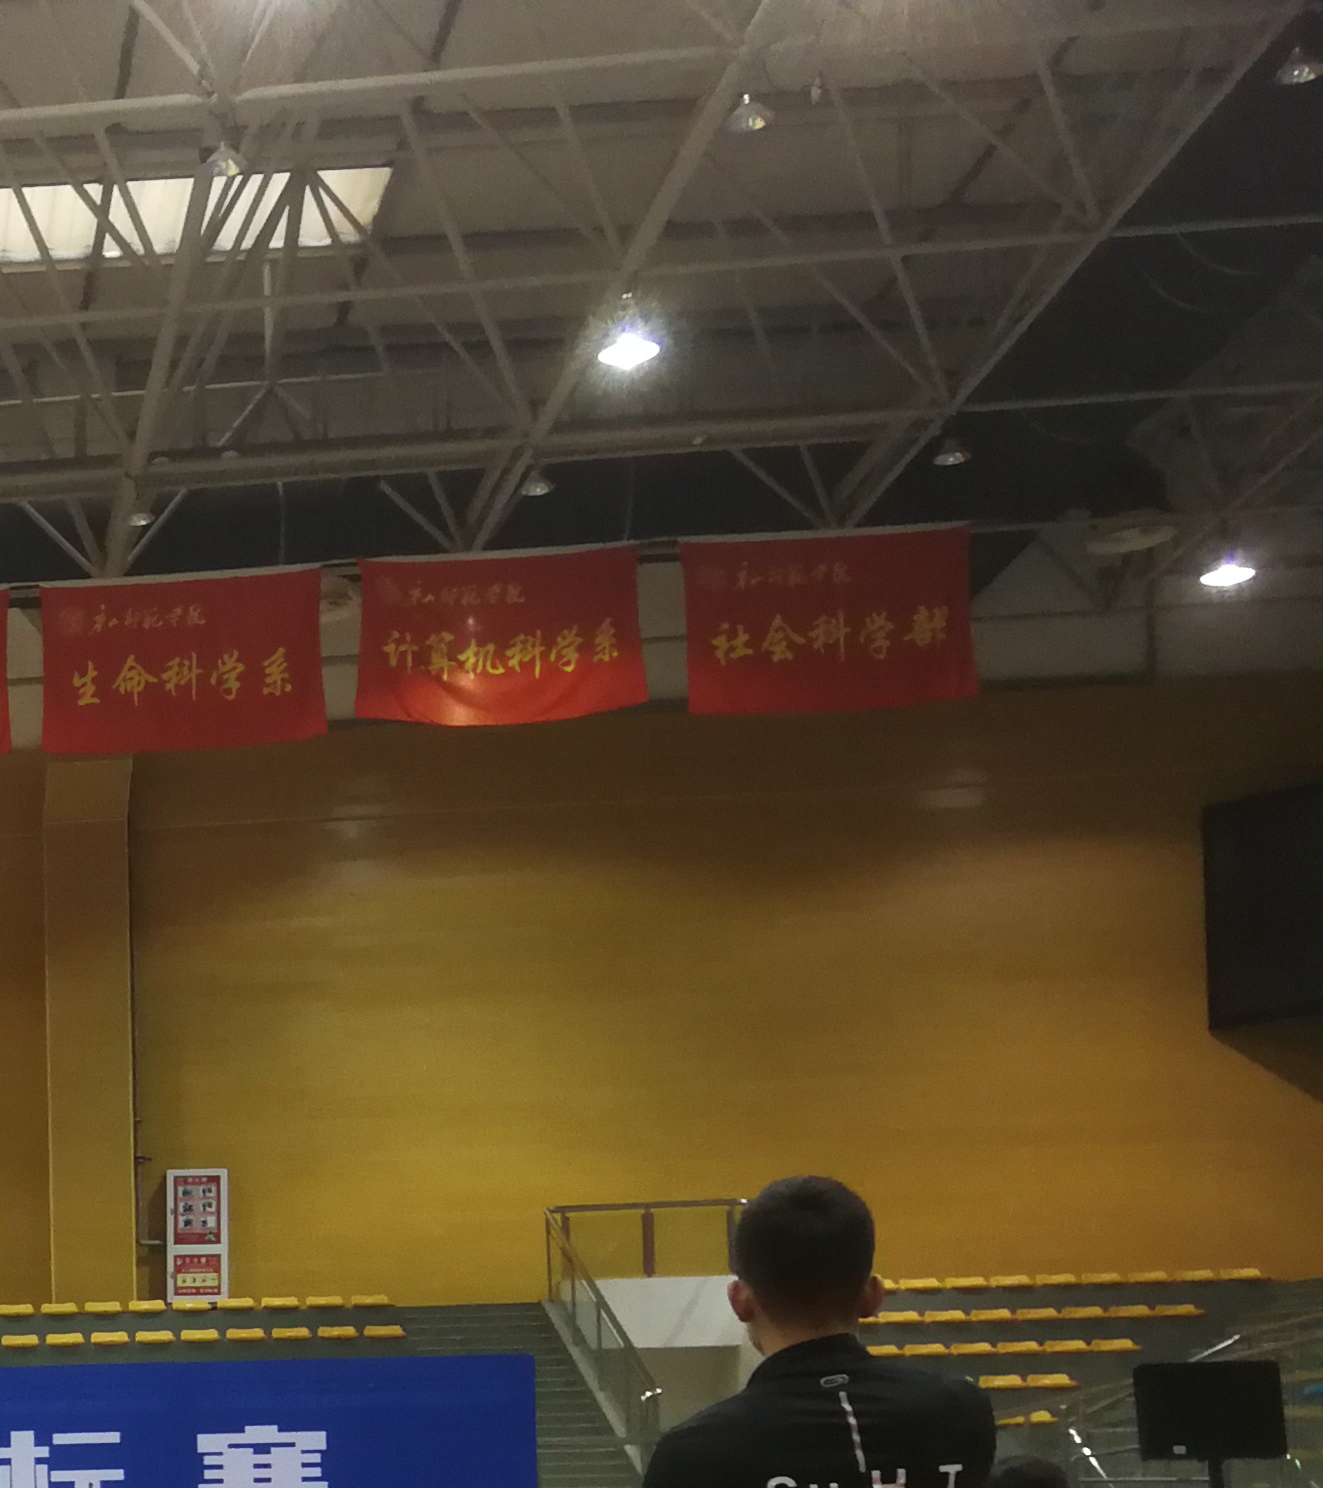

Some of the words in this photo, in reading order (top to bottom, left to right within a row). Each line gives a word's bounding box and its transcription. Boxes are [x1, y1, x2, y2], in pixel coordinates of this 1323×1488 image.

[383, 617, 619, 680] 计算机科学系
[710, 604, 949, 666] 社会科学部
[72, 646, 294, 706] 生命科学系
